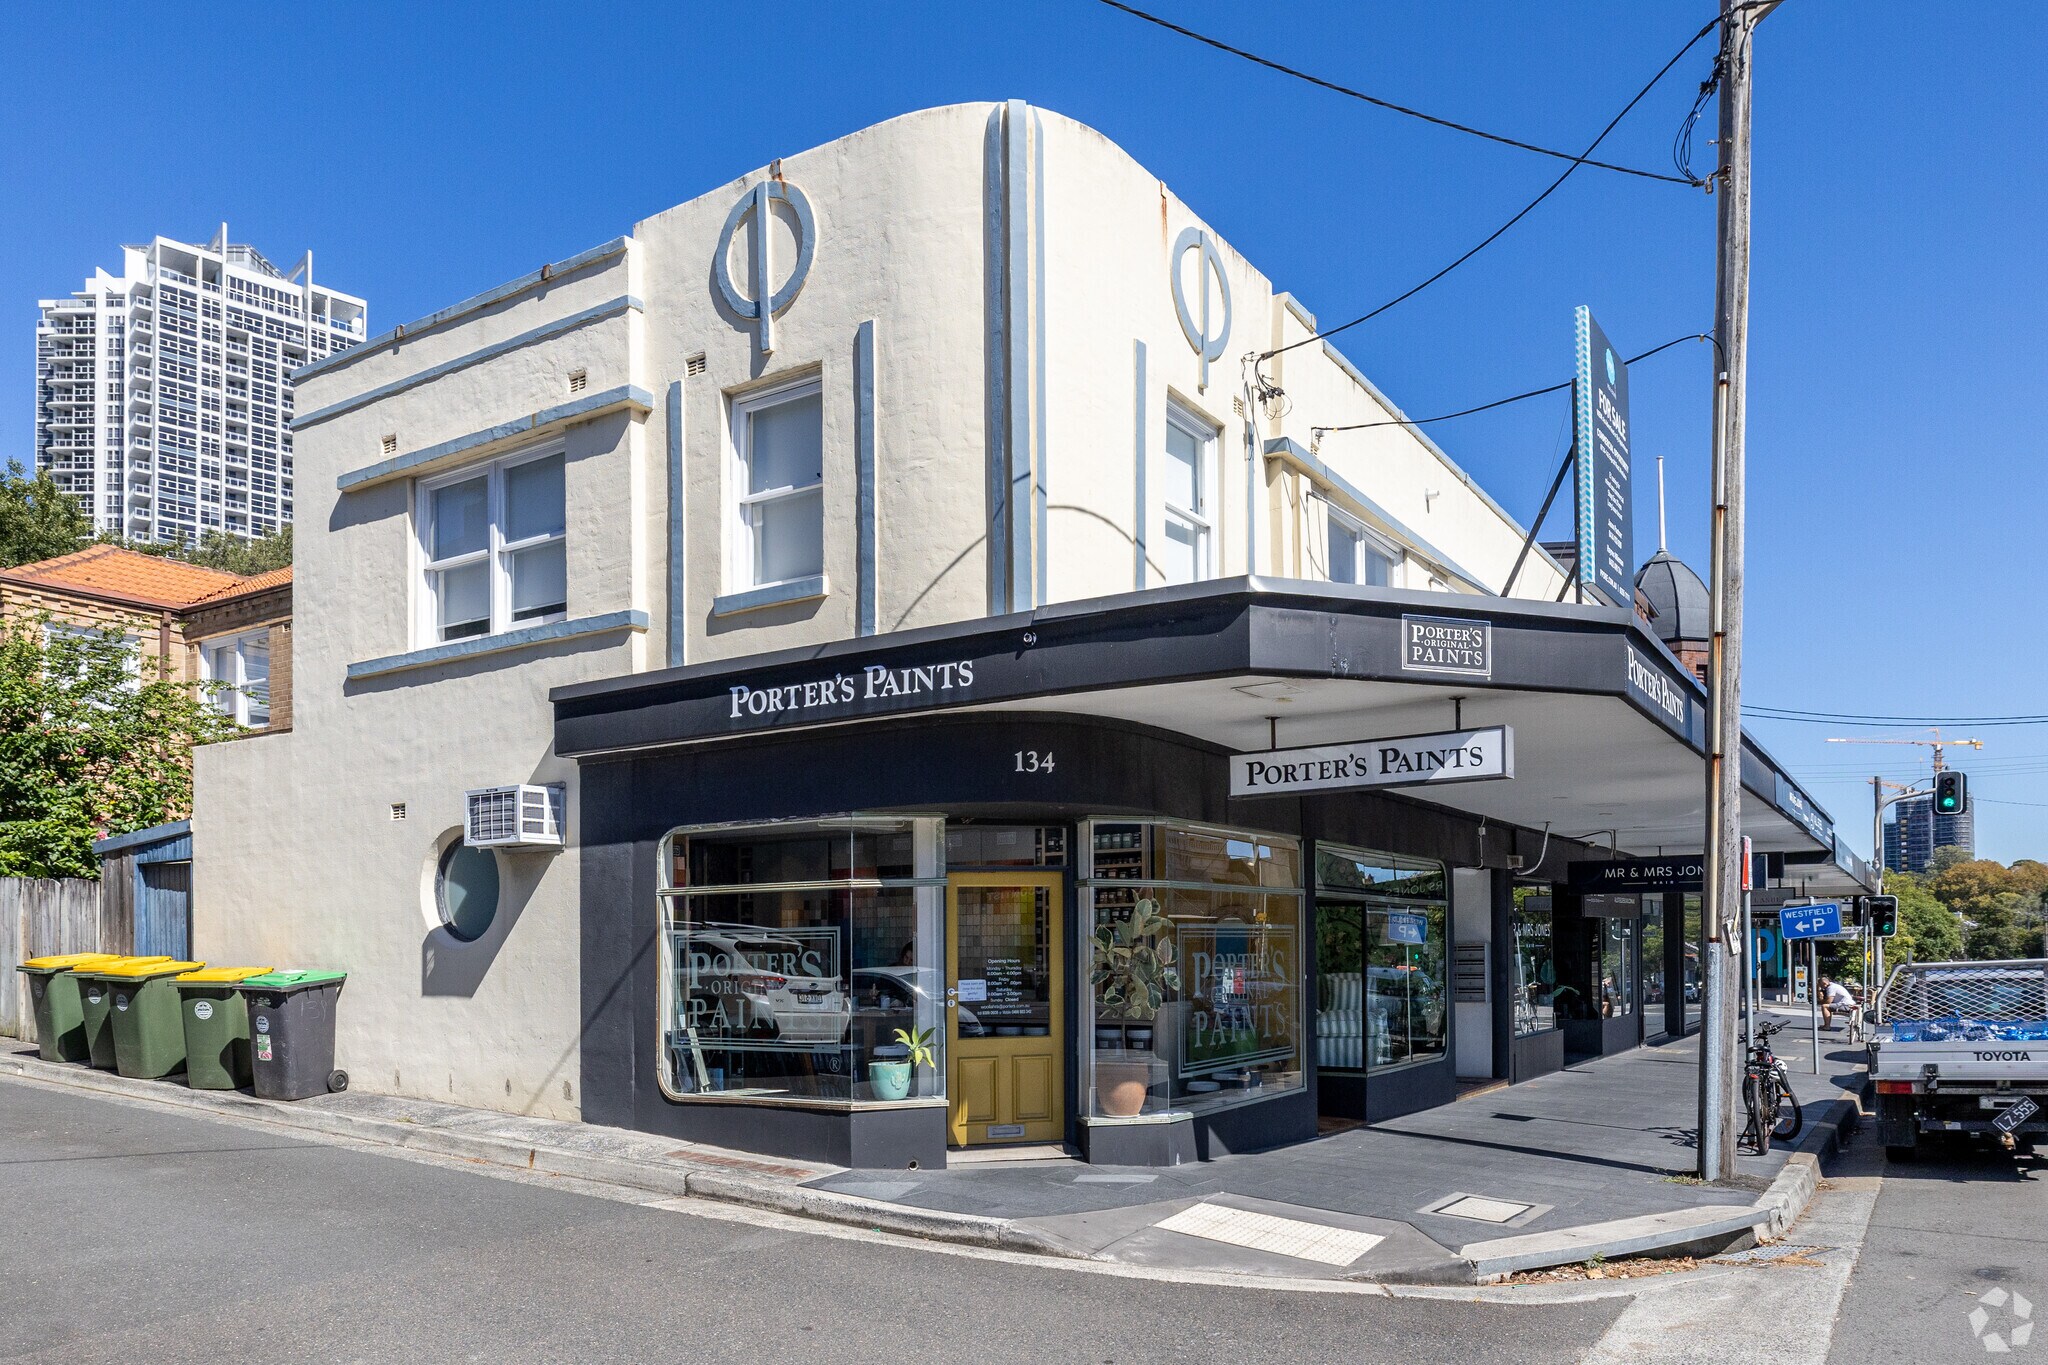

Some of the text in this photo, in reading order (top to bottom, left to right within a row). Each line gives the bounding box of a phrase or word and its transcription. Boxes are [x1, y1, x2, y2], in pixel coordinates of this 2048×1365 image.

[1598, 388, 1611, 421] FOR
[1611, 406, 1626, 441] SALE
[1411, 624, 1482, 648] PORTER'S
[1412, 646, 1483, 666] PAINTS
[729, 660, 974, 718] PORTER'S PAINTS
[1627, 645, 1684, 723] PORTER'S PAINTS
[1014, 750, 1056, 774] 134
[1246, 746, 1484, 787] PORTER'S PAINTS
[1605, 868, 1625, 878] MR
[1630, 867, 1639, 877] &
[1644, 866, 1673, 876] MRS
[1785, 907, 1834, 919] WESTFIELD
[1812, 918, 1825, 932] P
[1192, 945, 1287, 998] PORTER'S
[1973, 1051, 2031, 1061] TOYOTA
